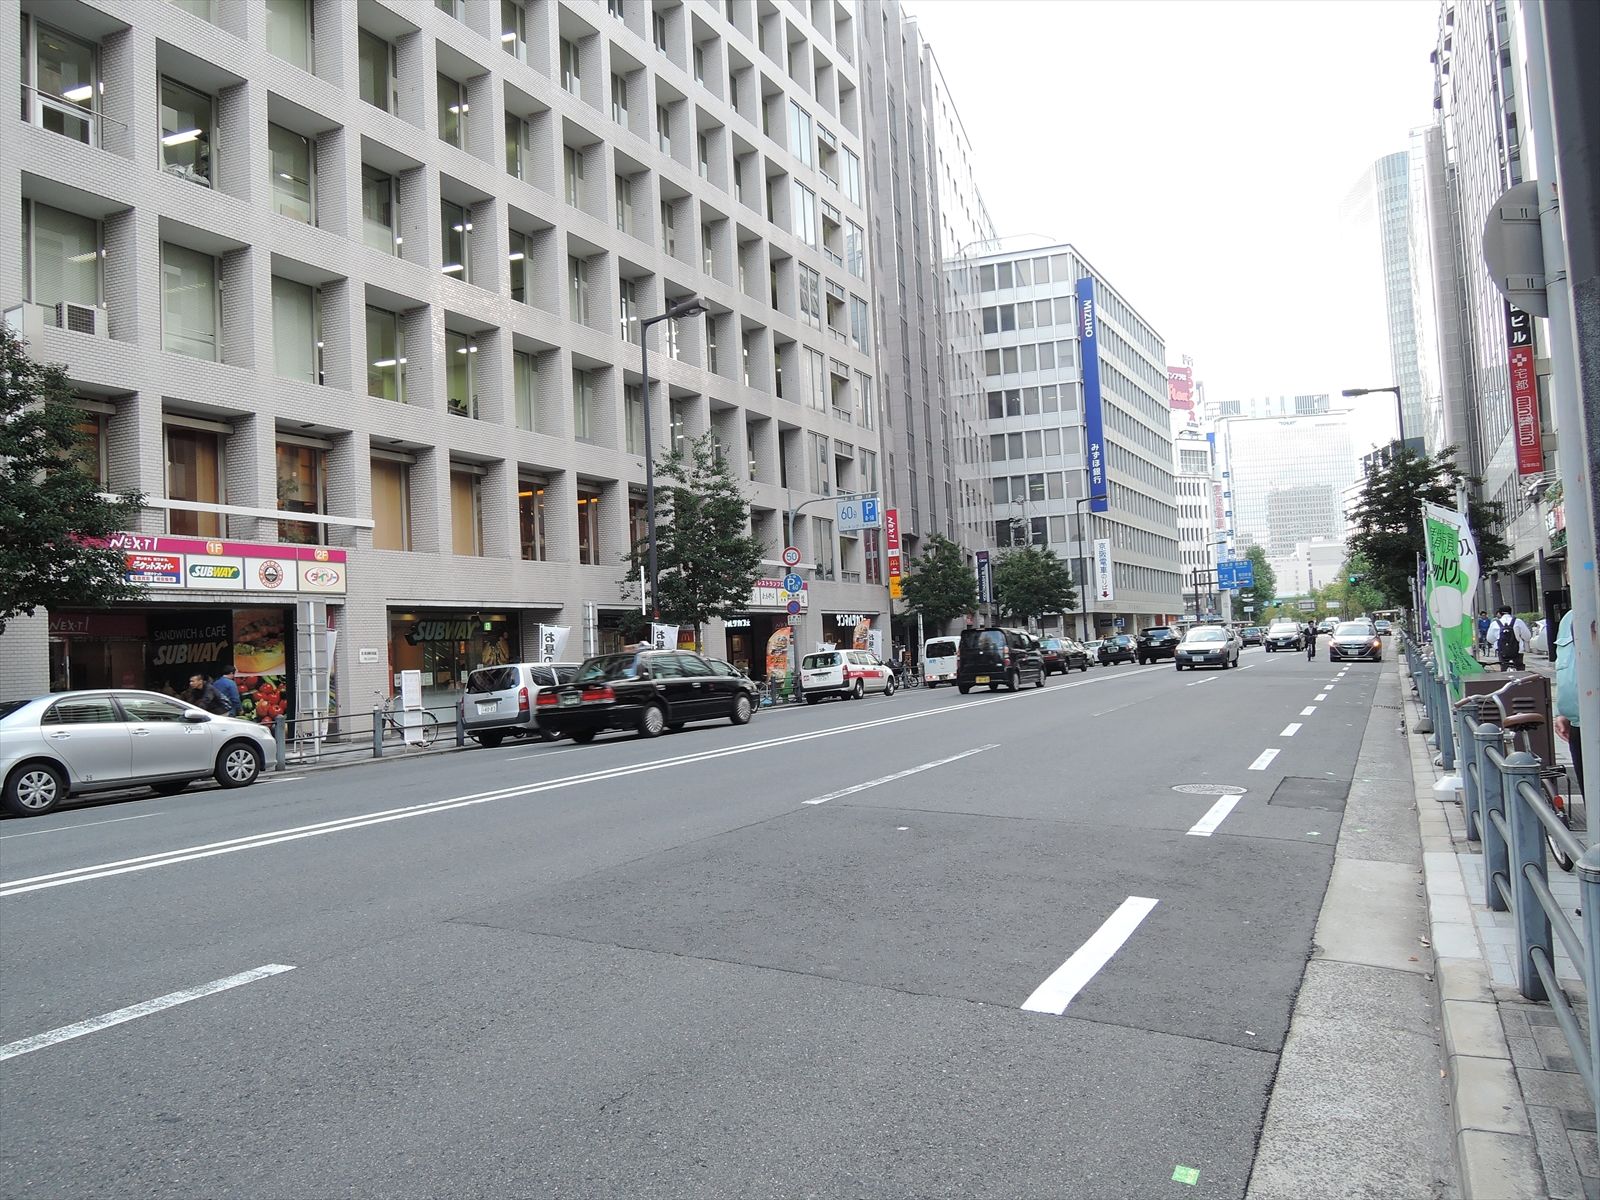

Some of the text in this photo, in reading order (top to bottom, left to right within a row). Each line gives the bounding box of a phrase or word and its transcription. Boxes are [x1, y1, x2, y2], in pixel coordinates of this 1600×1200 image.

[1083, 299, 1094, 338] MIZUHO
[1090, 443, 1102, 485] みずほ銀行
[865, 501, 874, 515] P
[786, 552, 798, 561] 50
[191, 566, 239, 578] SUBWAY
[1098, 542, 1109, 591] 京阪電車のりば
[787, 578, 796, 591] P
[154, 629, 197, 640] SANDWICH
[412, 621, 480, 641] SUBWAY
[152, 640, 228, 666] SUBWAY
